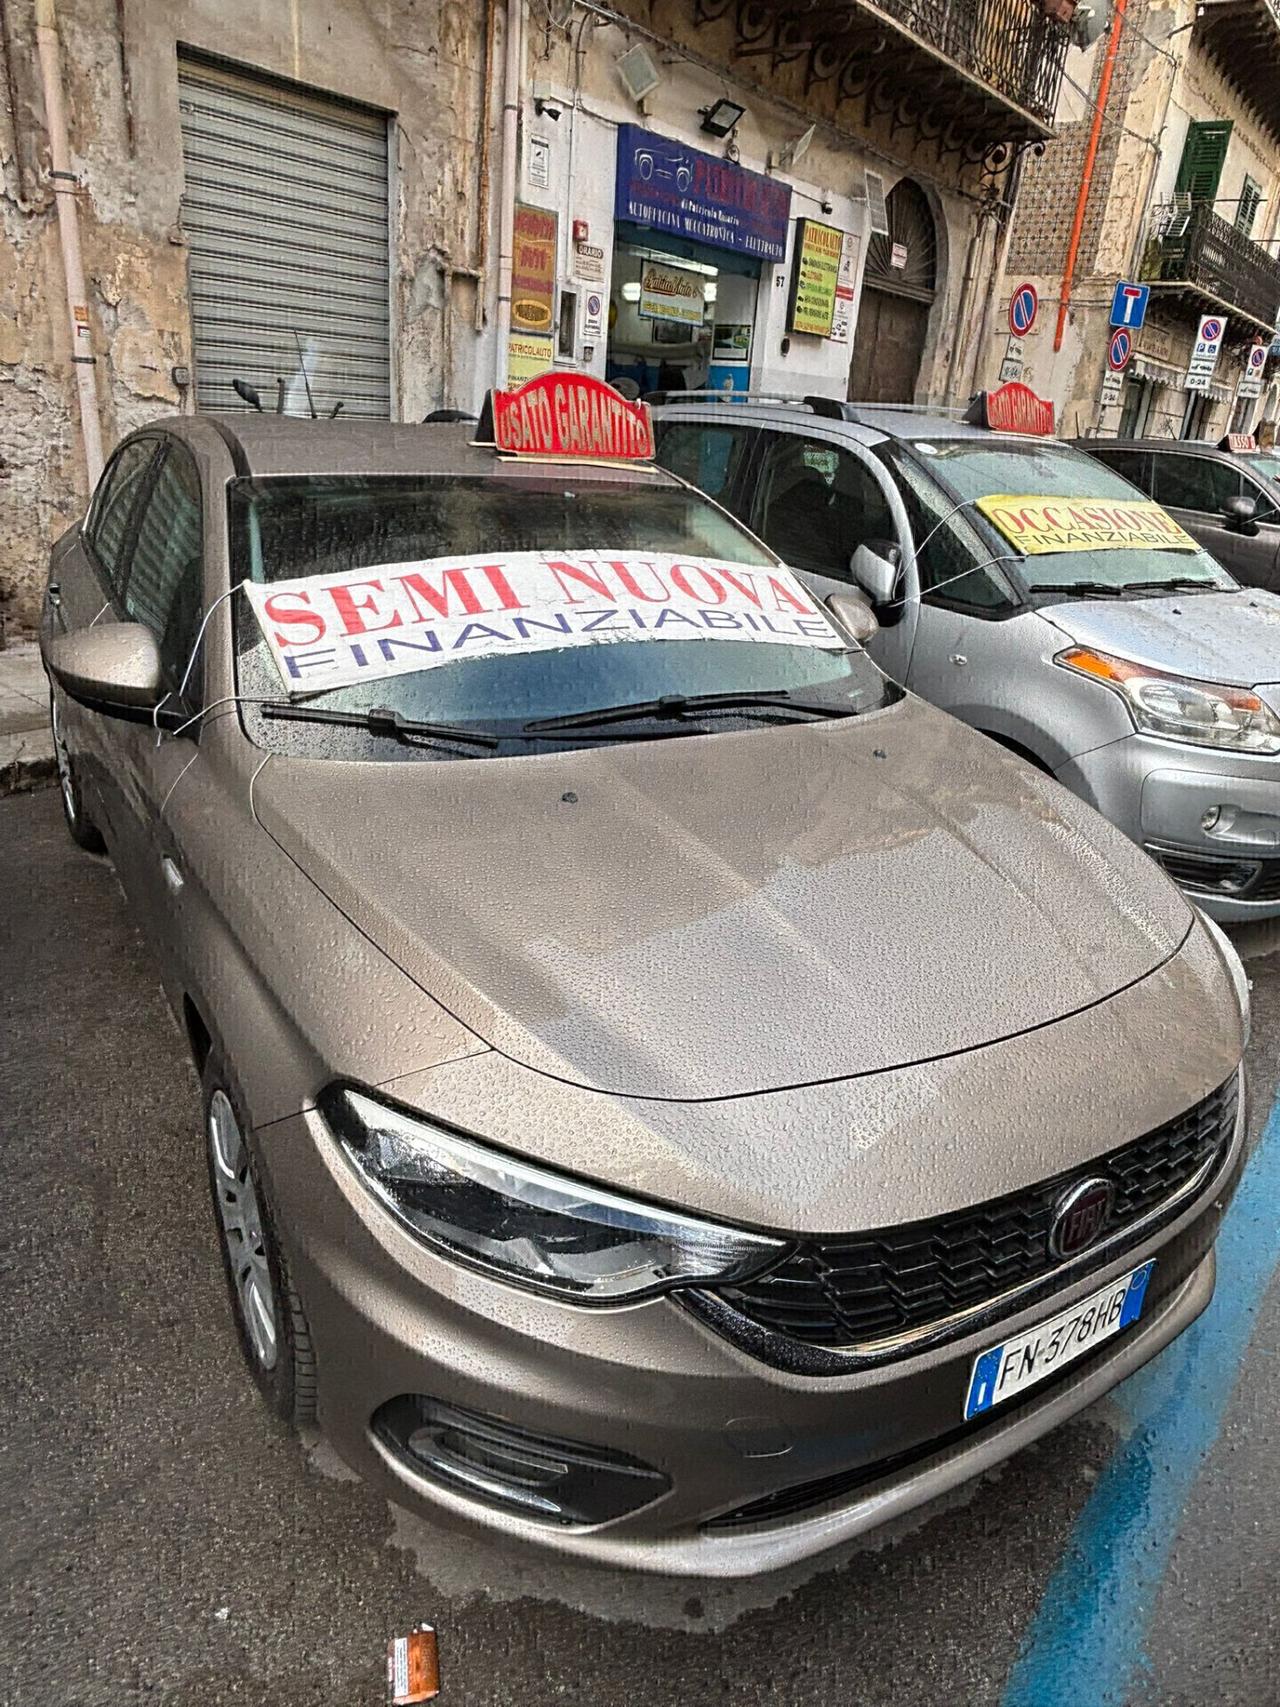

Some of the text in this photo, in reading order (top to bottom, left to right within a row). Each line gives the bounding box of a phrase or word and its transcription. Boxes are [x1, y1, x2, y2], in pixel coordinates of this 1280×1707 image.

[629, 201, 680, 228] AUTOFFICINA
[578, 246, 602, 258] ORARIO
[776, 276, 785, 288] 57
[508, 343, 552, 359] PATRICOLAUTO
[1190, 378, 1206, 386] 0-24
[500, 384, 648, 455] USATO GARANTITO
[992, 506, 1182, 535] OCCASIONE
[1015, 531, 1193, 545] FINANZIABILE
[263, 560, 817, 648] SEMI NUOVA
[284, 608, 837, 679] FINANZIABILE
